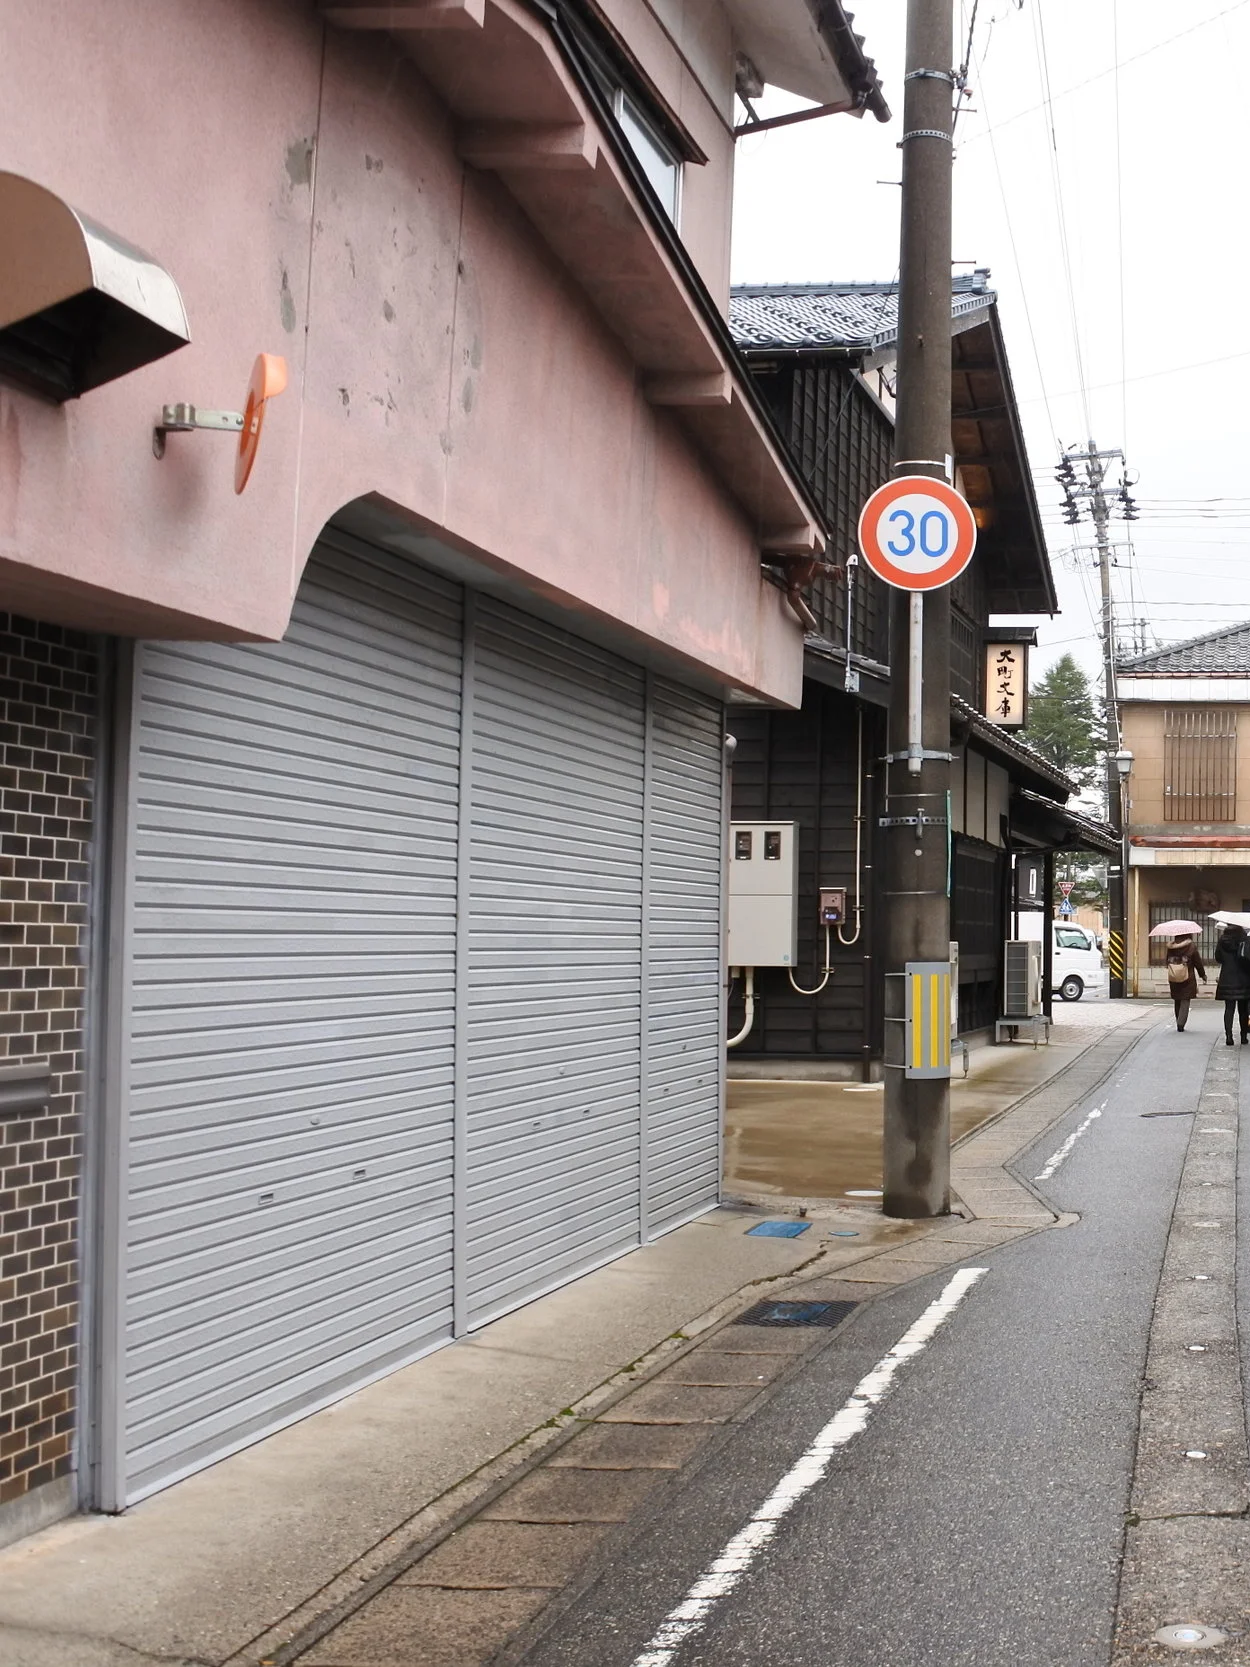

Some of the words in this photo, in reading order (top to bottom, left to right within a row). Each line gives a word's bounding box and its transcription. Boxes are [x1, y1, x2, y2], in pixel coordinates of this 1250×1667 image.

[888, 510, 948, 557] 30
[995, 649, 1016, 718] 大町文庫
